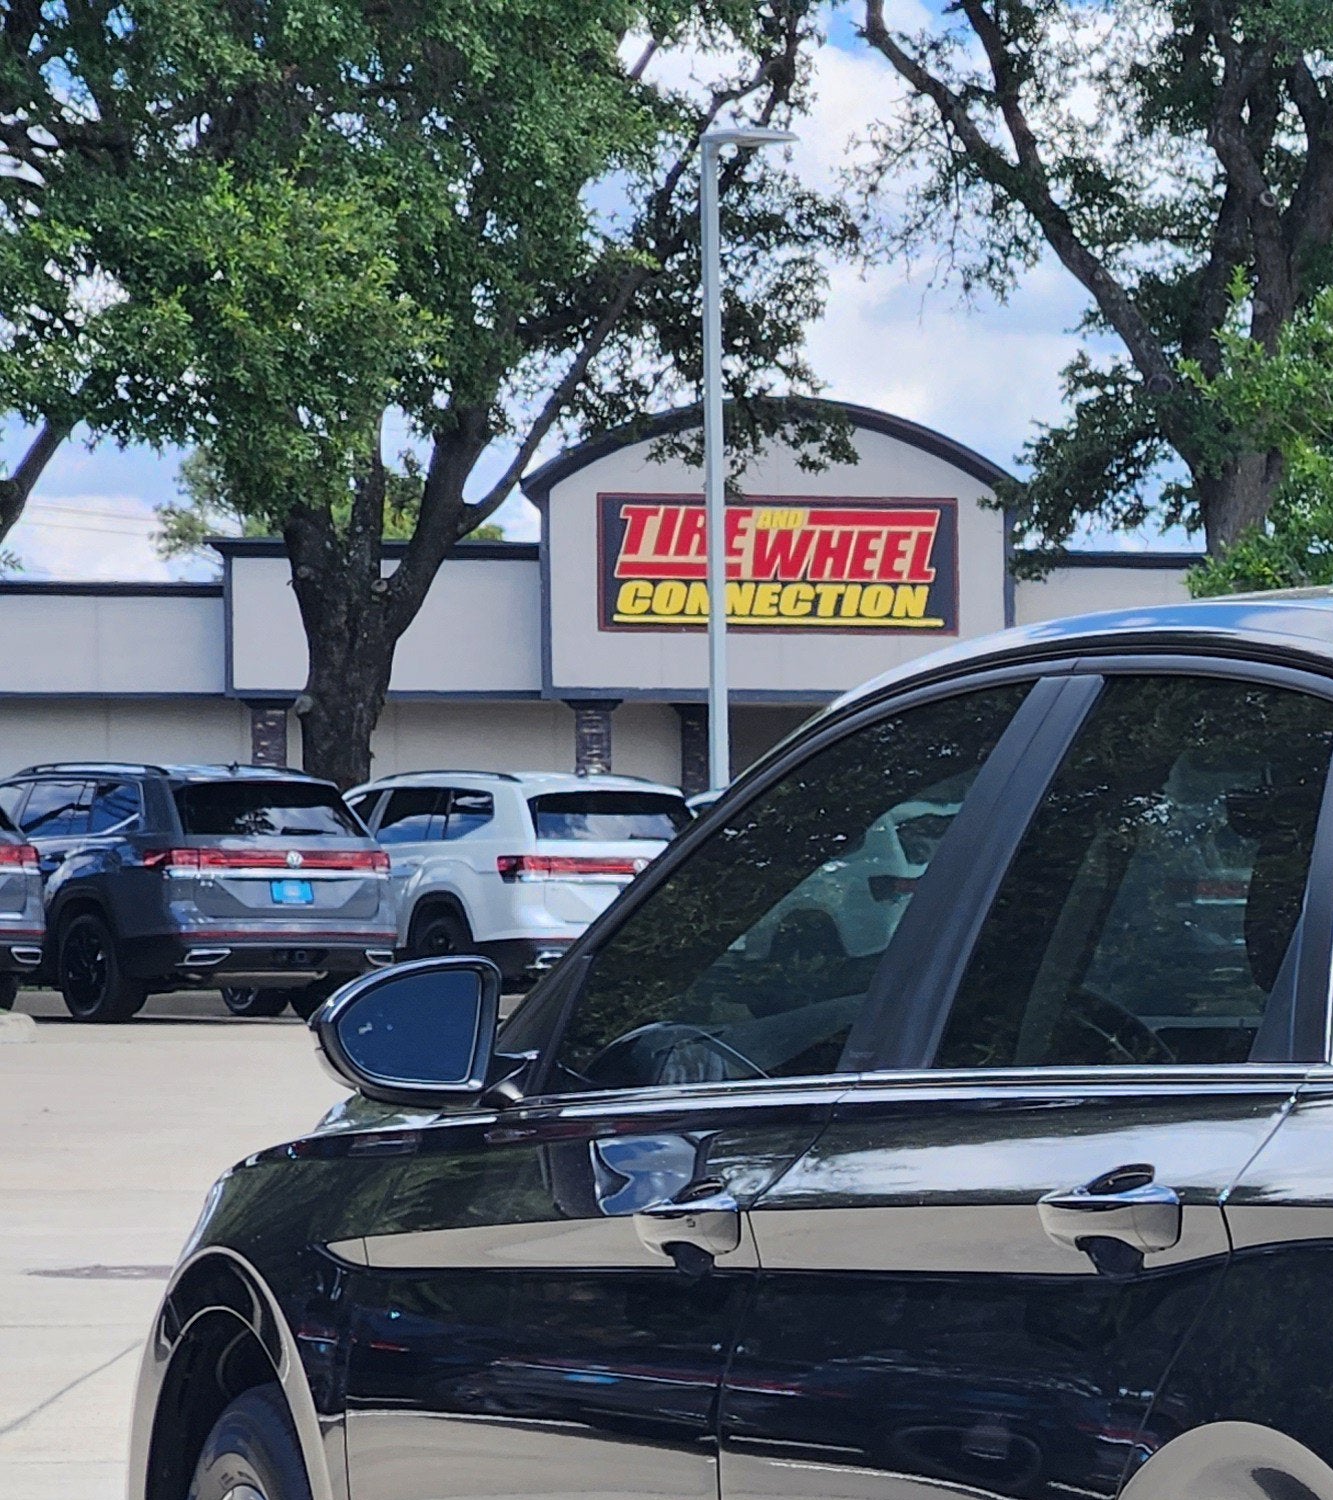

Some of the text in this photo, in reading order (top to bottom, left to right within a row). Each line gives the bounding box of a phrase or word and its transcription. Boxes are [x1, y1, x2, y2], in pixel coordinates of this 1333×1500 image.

[620, 505, 753, 557] TIRE
[756, 509, 804, 529] AND
[752, 529, 936, 581] WHEEL
[616, 580, 930, 618] CONNECTION
